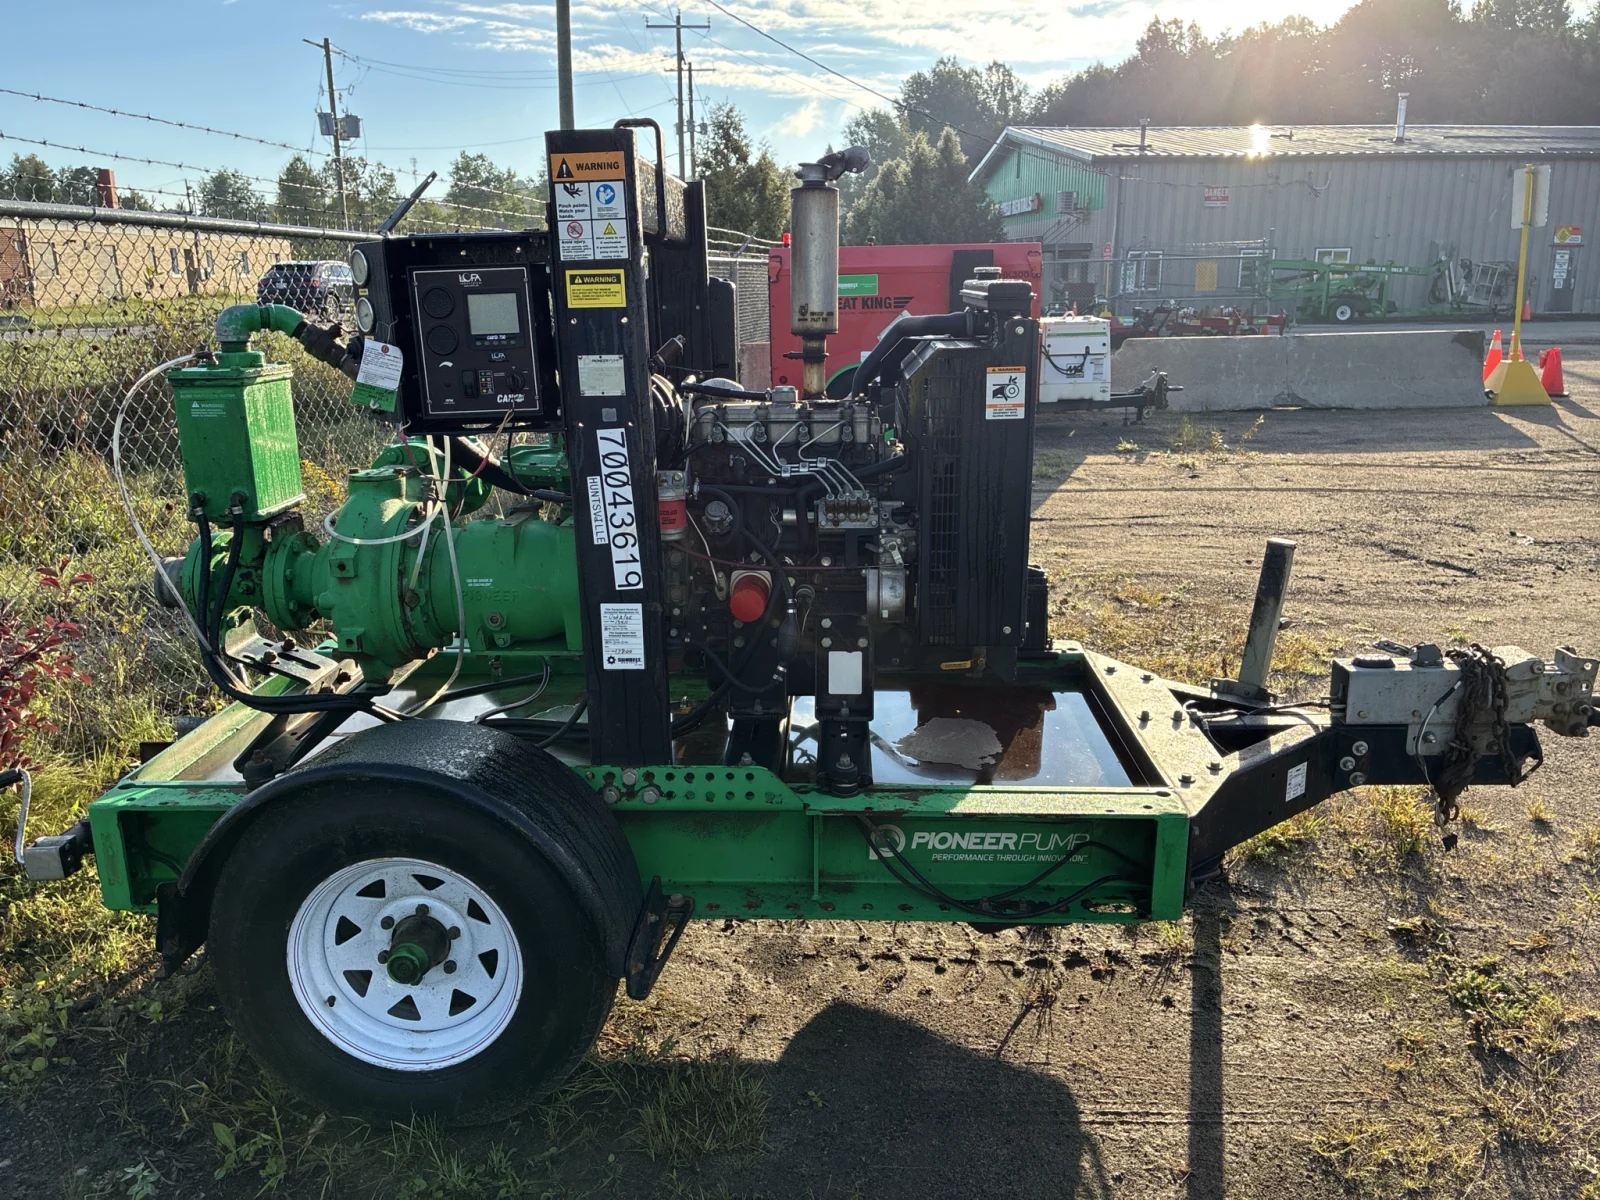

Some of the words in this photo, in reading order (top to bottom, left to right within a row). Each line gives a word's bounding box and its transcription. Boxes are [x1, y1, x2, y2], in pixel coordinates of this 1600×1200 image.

[576, 162, 619, 172] WARNING
[838, 298, 858, 310] EAT
[862, 296, 892, 309] KING
[588, 477, 606, 544] HUNTSVILLE
[600, 432, 642, 588] 70043619
